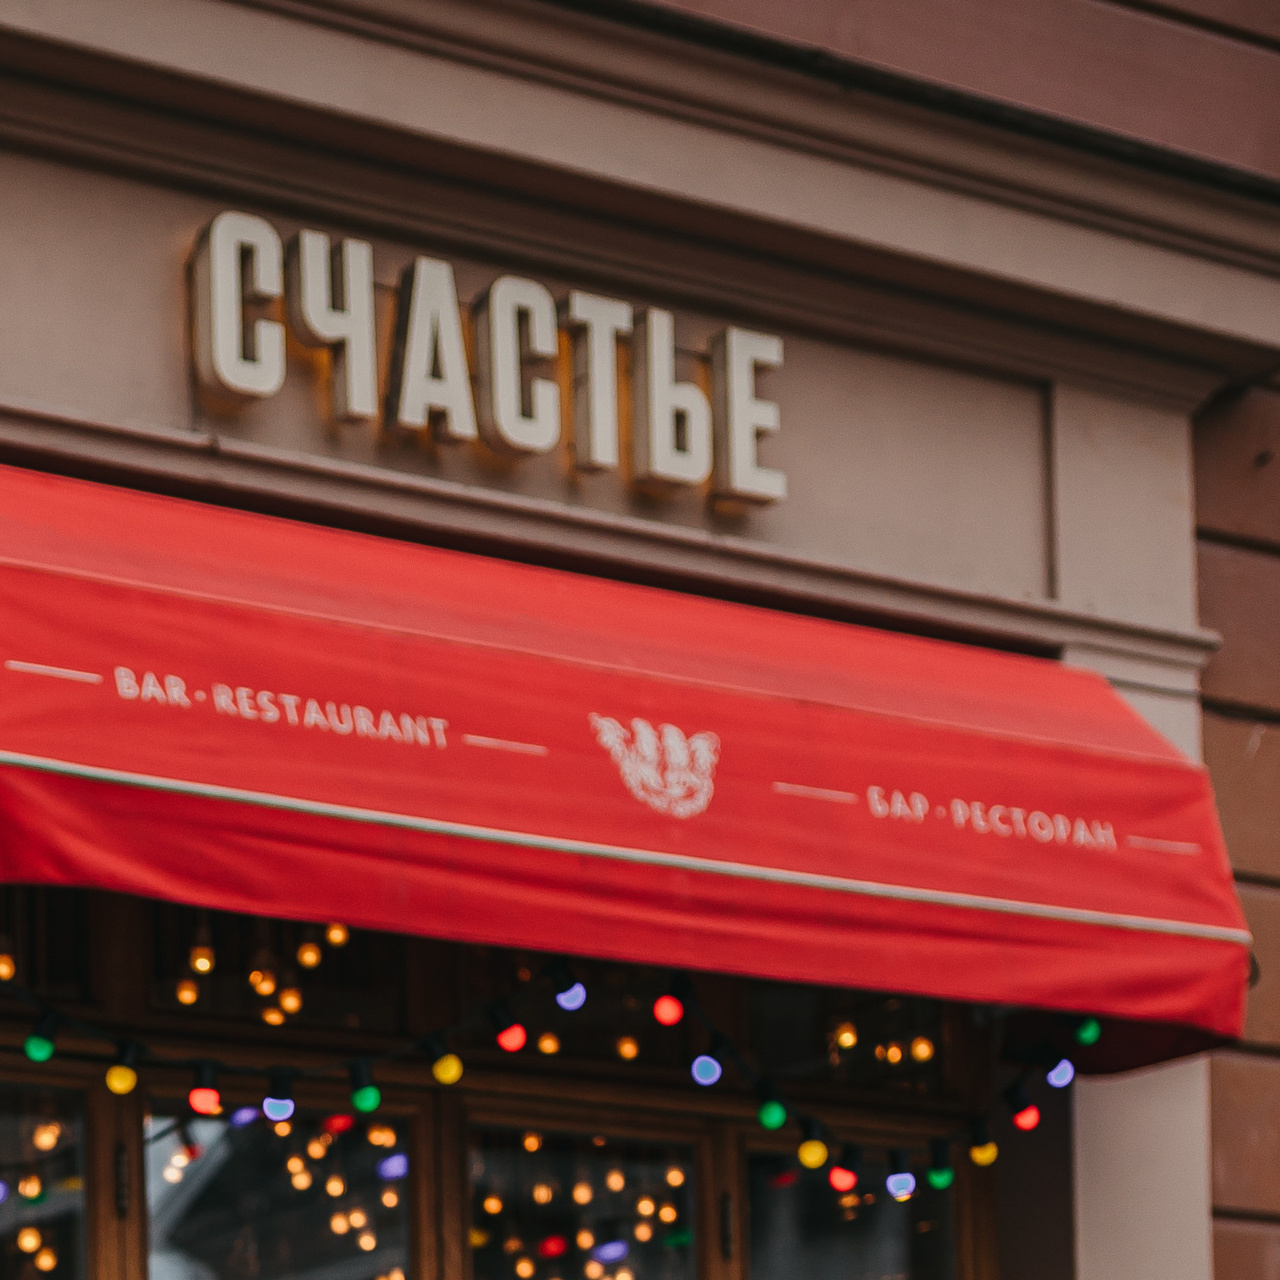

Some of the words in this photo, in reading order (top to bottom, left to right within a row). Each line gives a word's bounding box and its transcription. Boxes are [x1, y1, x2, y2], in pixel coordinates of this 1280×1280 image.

[204, 209, 788, 502] СЧАСТЬЕ
[113, 665, 192, 708] BAR
[211, 682, 450, 750] RESTAURANT
[865, 784, 930, 824] БАР
[949, 797, 1119, 852] РЕСТОРАН
